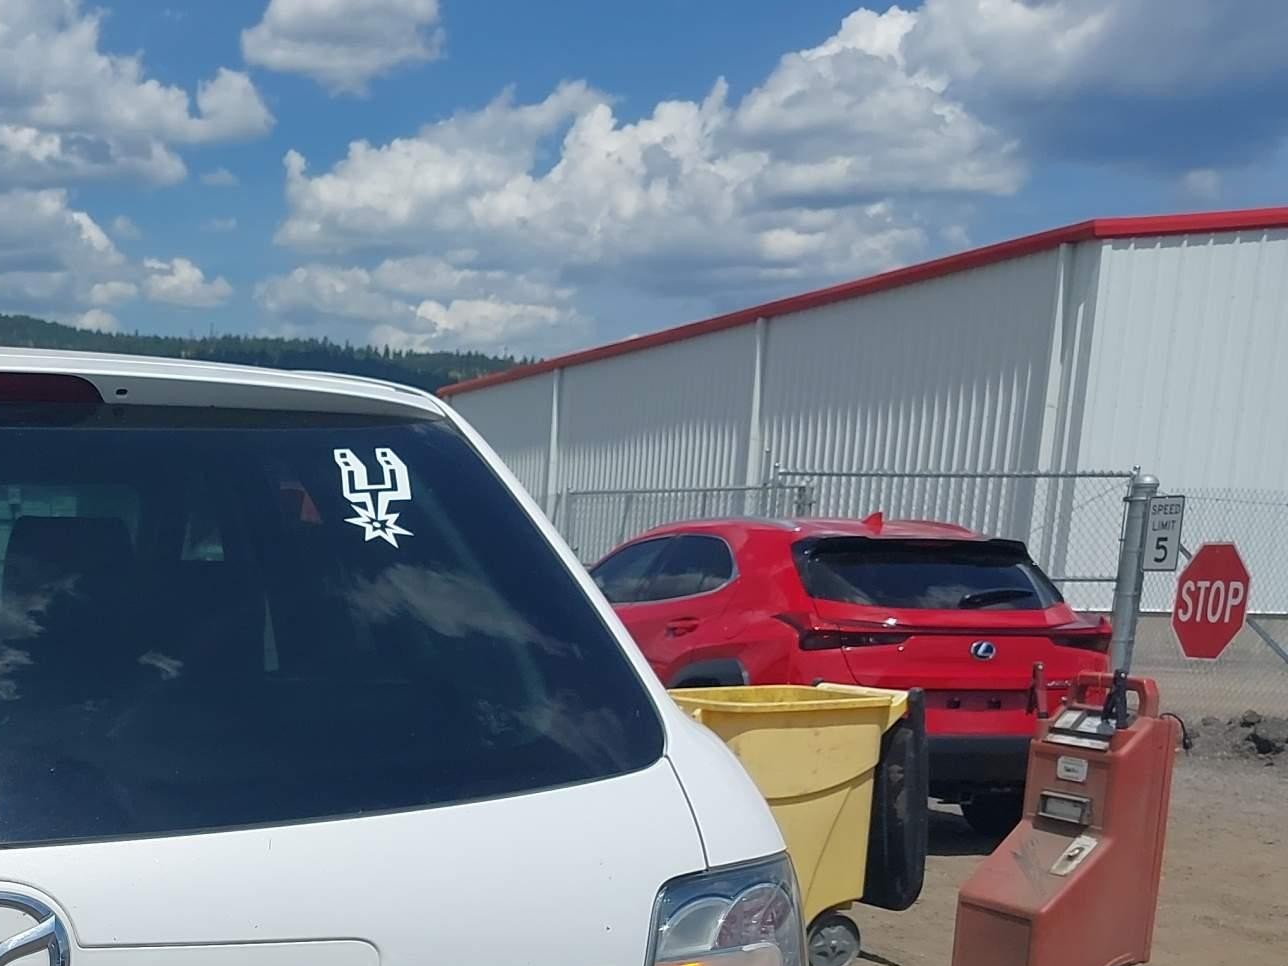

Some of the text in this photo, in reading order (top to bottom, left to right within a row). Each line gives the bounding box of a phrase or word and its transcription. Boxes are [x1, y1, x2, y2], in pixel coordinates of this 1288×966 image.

[1151, 503, 1181, 515] SPEED
[1152, 519, 1176, 531] LIMIT
[1153, 537, 1169, 563] 5
[1178, 580, 1244, 623] STOP
